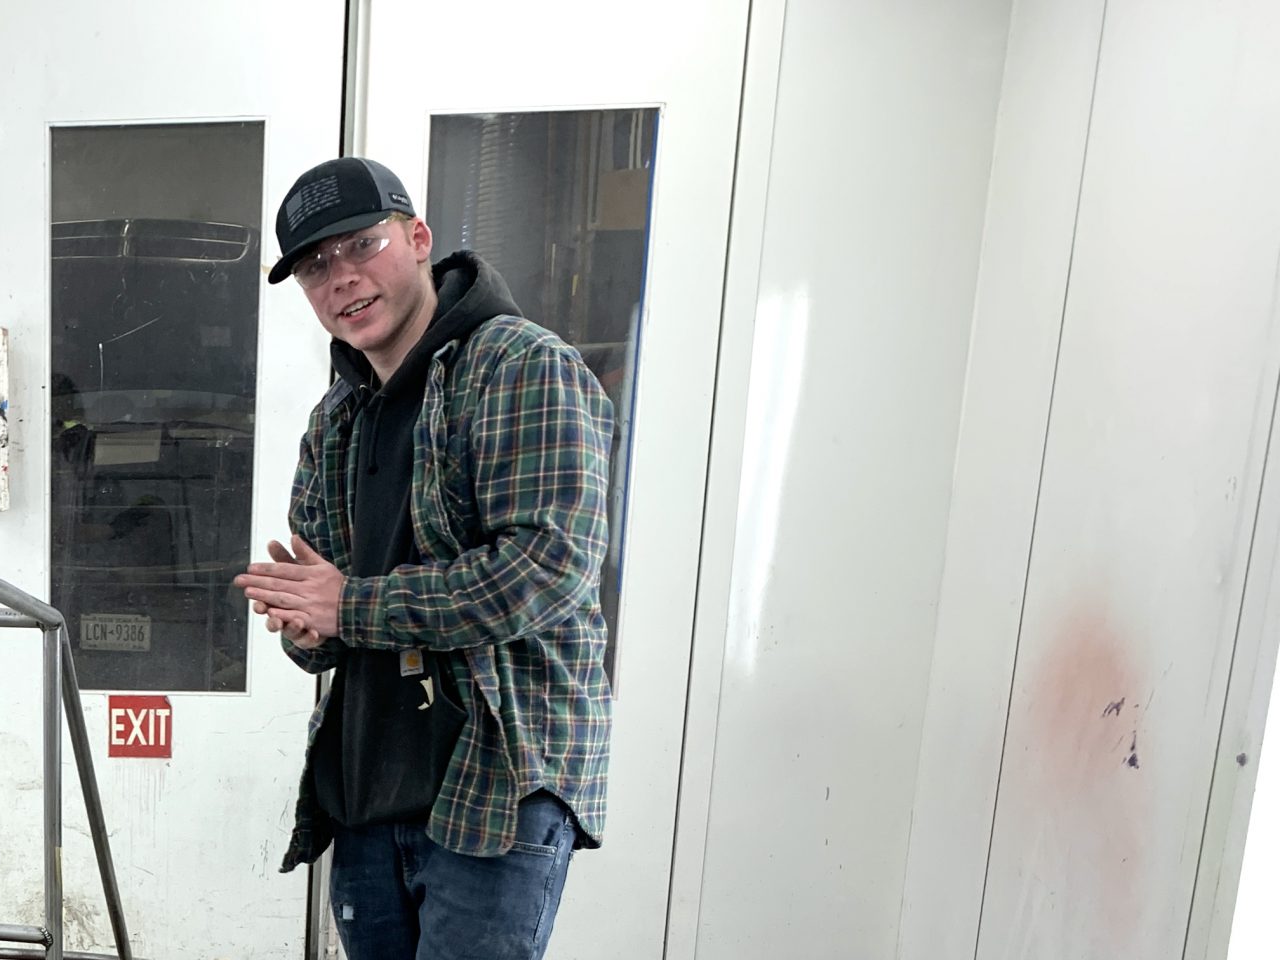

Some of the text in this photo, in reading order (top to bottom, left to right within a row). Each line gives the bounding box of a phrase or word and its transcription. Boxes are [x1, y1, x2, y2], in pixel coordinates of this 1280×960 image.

[85, 623, 145, 642] LCN 9386
[111, 708, 170, 746] EXIT
